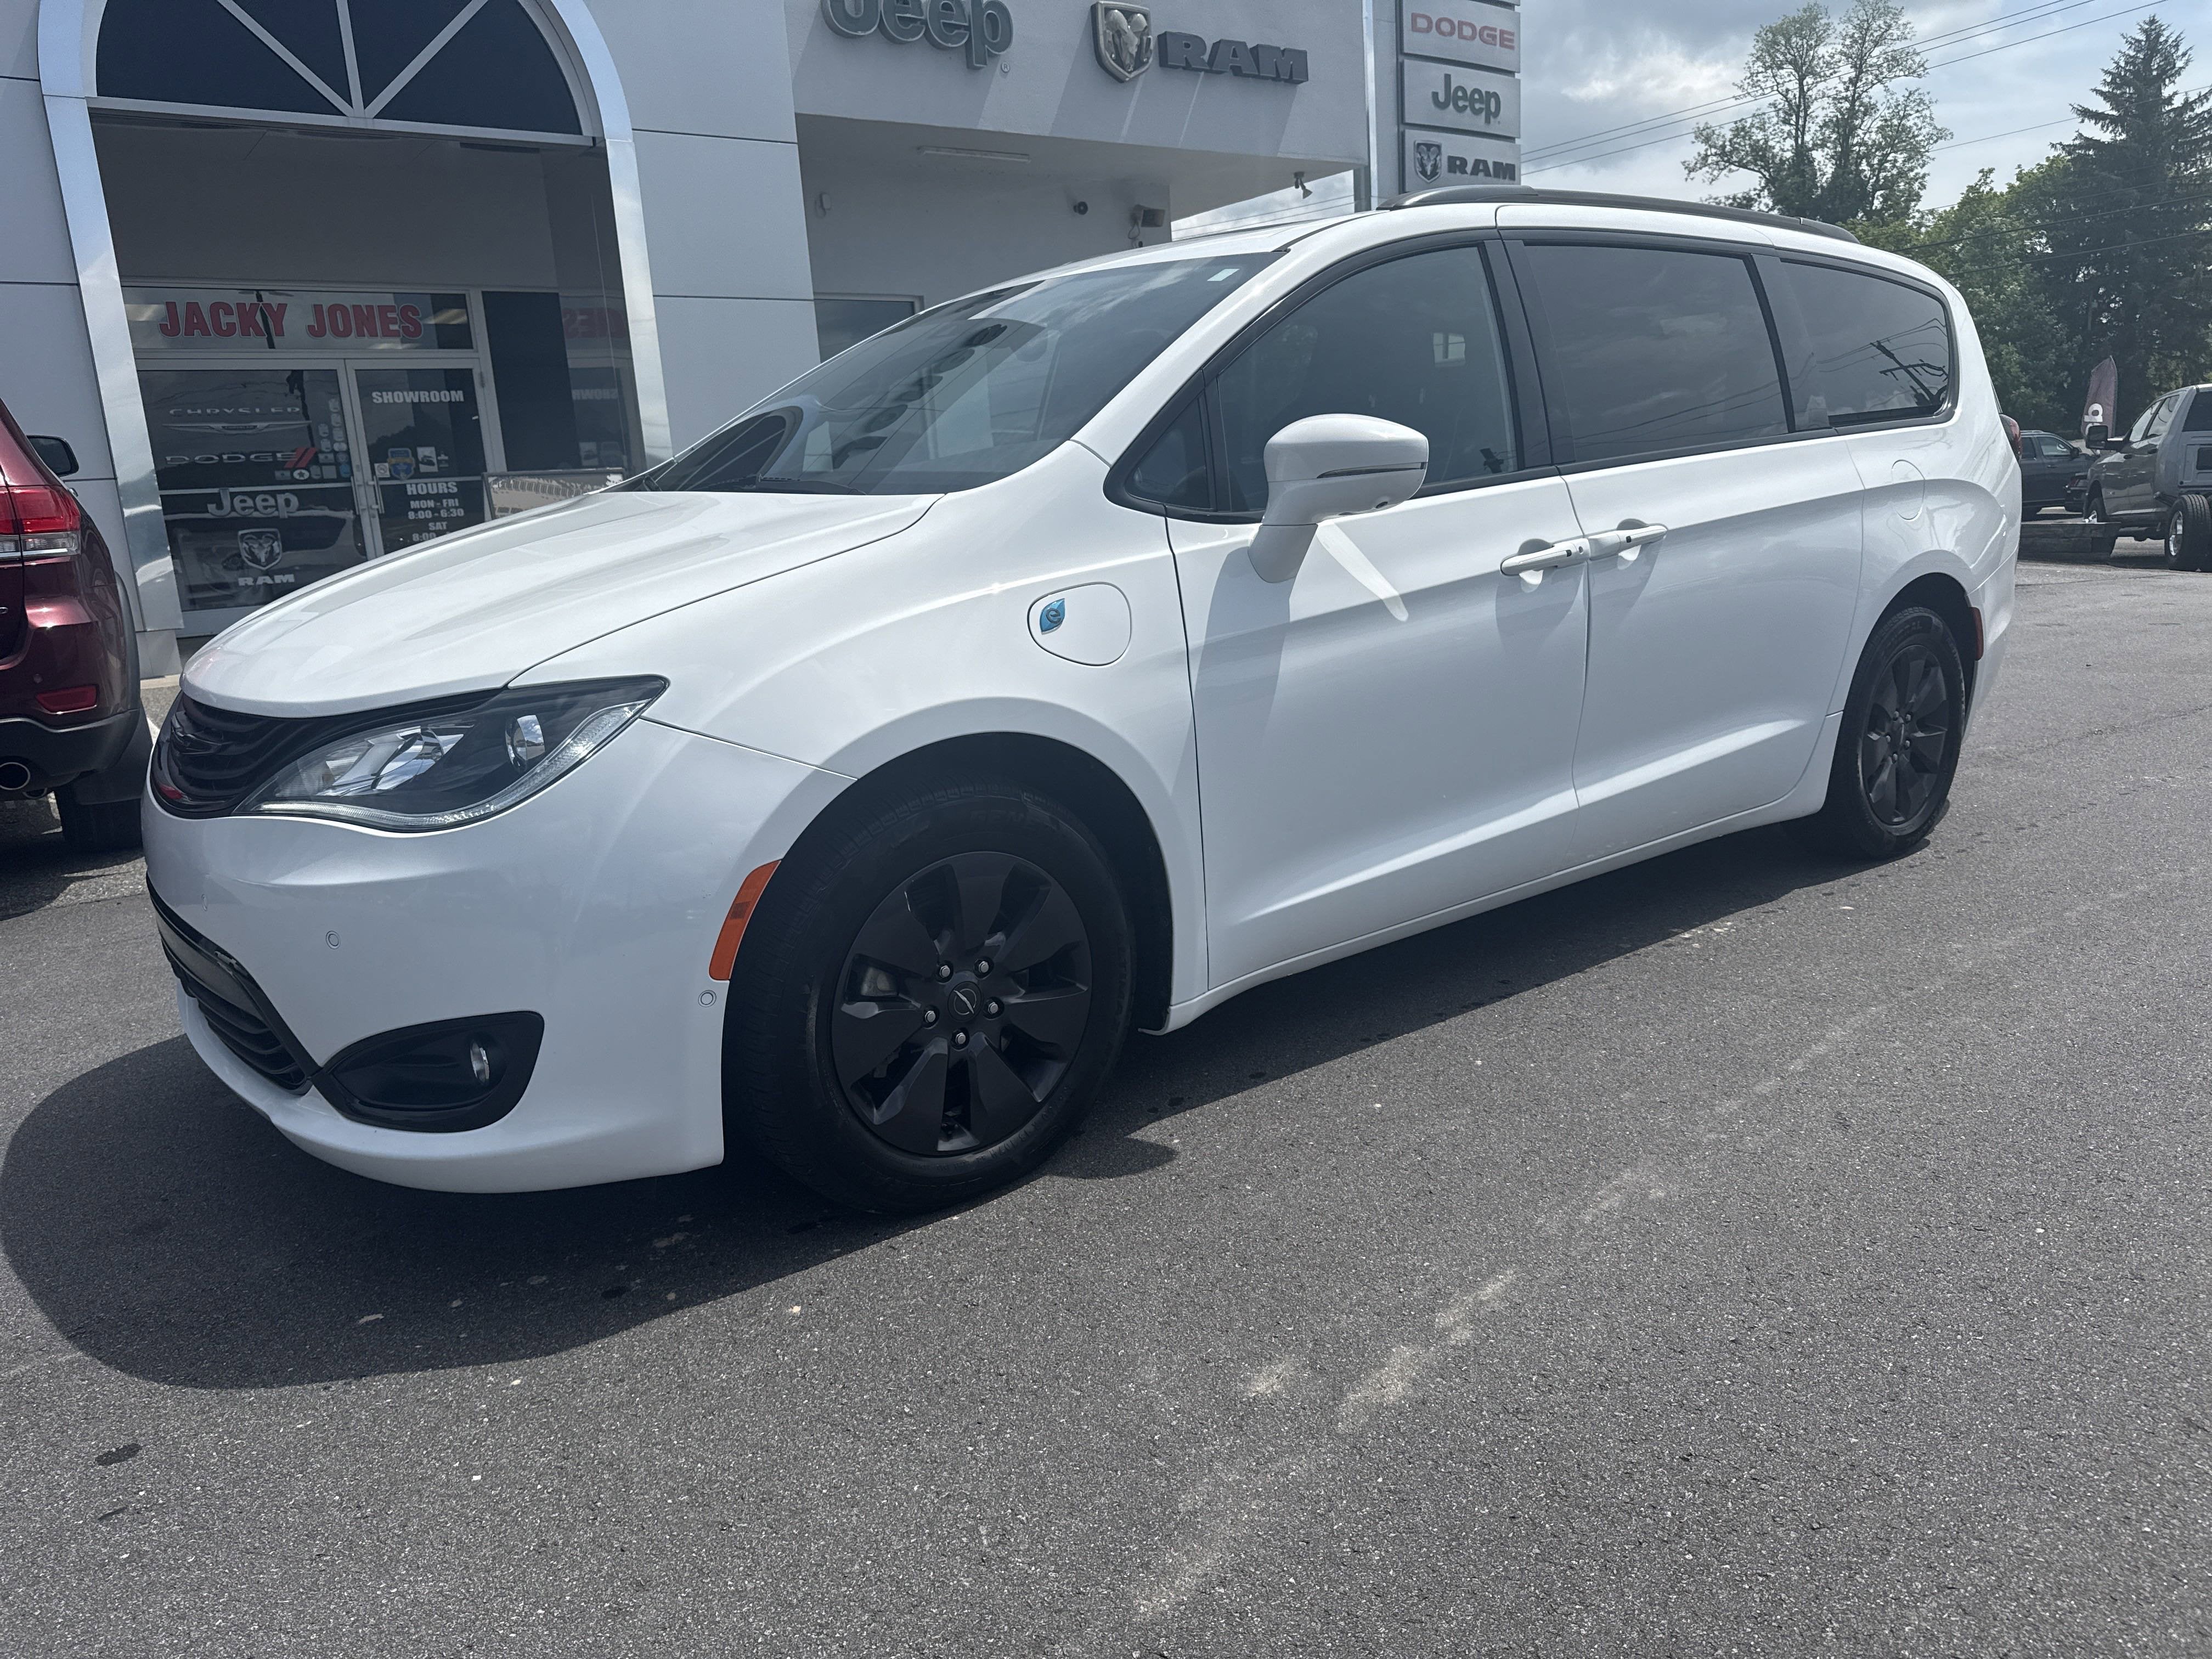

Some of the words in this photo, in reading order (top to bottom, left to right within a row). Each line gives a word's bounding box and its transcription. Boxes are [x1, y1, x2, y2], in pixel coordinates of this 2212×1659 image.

[821, 0, 1013, 69] Jeep
[1410, 12, 1515, 50] DODGE
[1158, 30, 1308, 83] RAM
[1431, 73, 1501, 124] Jeep
[1447, 155, 1516, 181] RAM
[158, 301, 288, 338] JACKY
[306, 303, 424, 339] JONES
[371, 390, 464, 403] SHOWROOM
[165, 452, 297, 465] DODGE
[406, 482, 458, 495] HOURS
[207, 488, 299, 518] Jeep
[410, 500, 435, 509] MON
[443, 498, 459, 507] FRI
[408, 510, 432, 520] 8:00
[441, 508, 464, 517] 6:30
[428, 522, 448, 531] SAT
[238, 574, 295, 586] RAM
